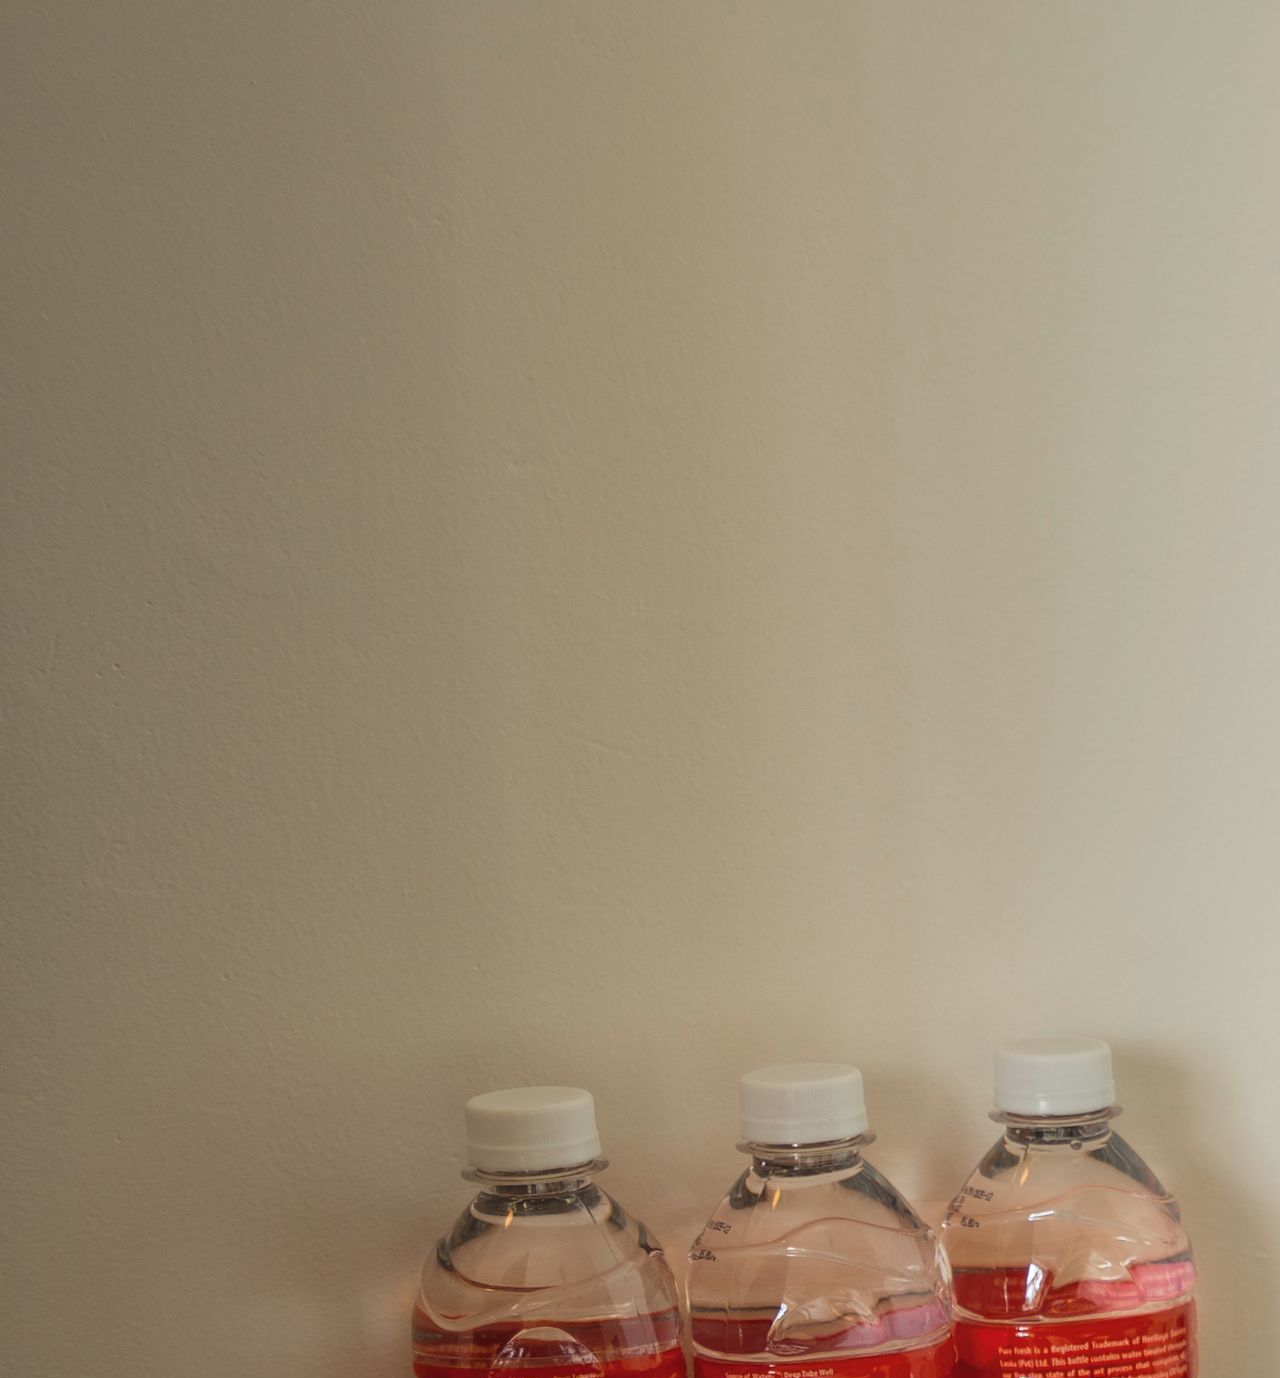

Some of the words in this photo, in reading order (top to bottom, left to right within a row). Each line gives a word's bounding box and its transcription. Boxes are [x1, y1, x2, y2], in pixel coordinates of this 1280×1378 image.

[1051, 1343, 1089, 1354] Registered
[1092, 1339, 1129, 1349] Trademark
[1132, 1337, 1140, 1345] of
[1051, 1357, 1066, 1366] This
[1068, 1355, 1089, 1365] bottle
[1122, 1351, 1142, 1360] water
[1067, 1369, 1075, 1378] of
[1078, 1369, 1090, 1377] the
